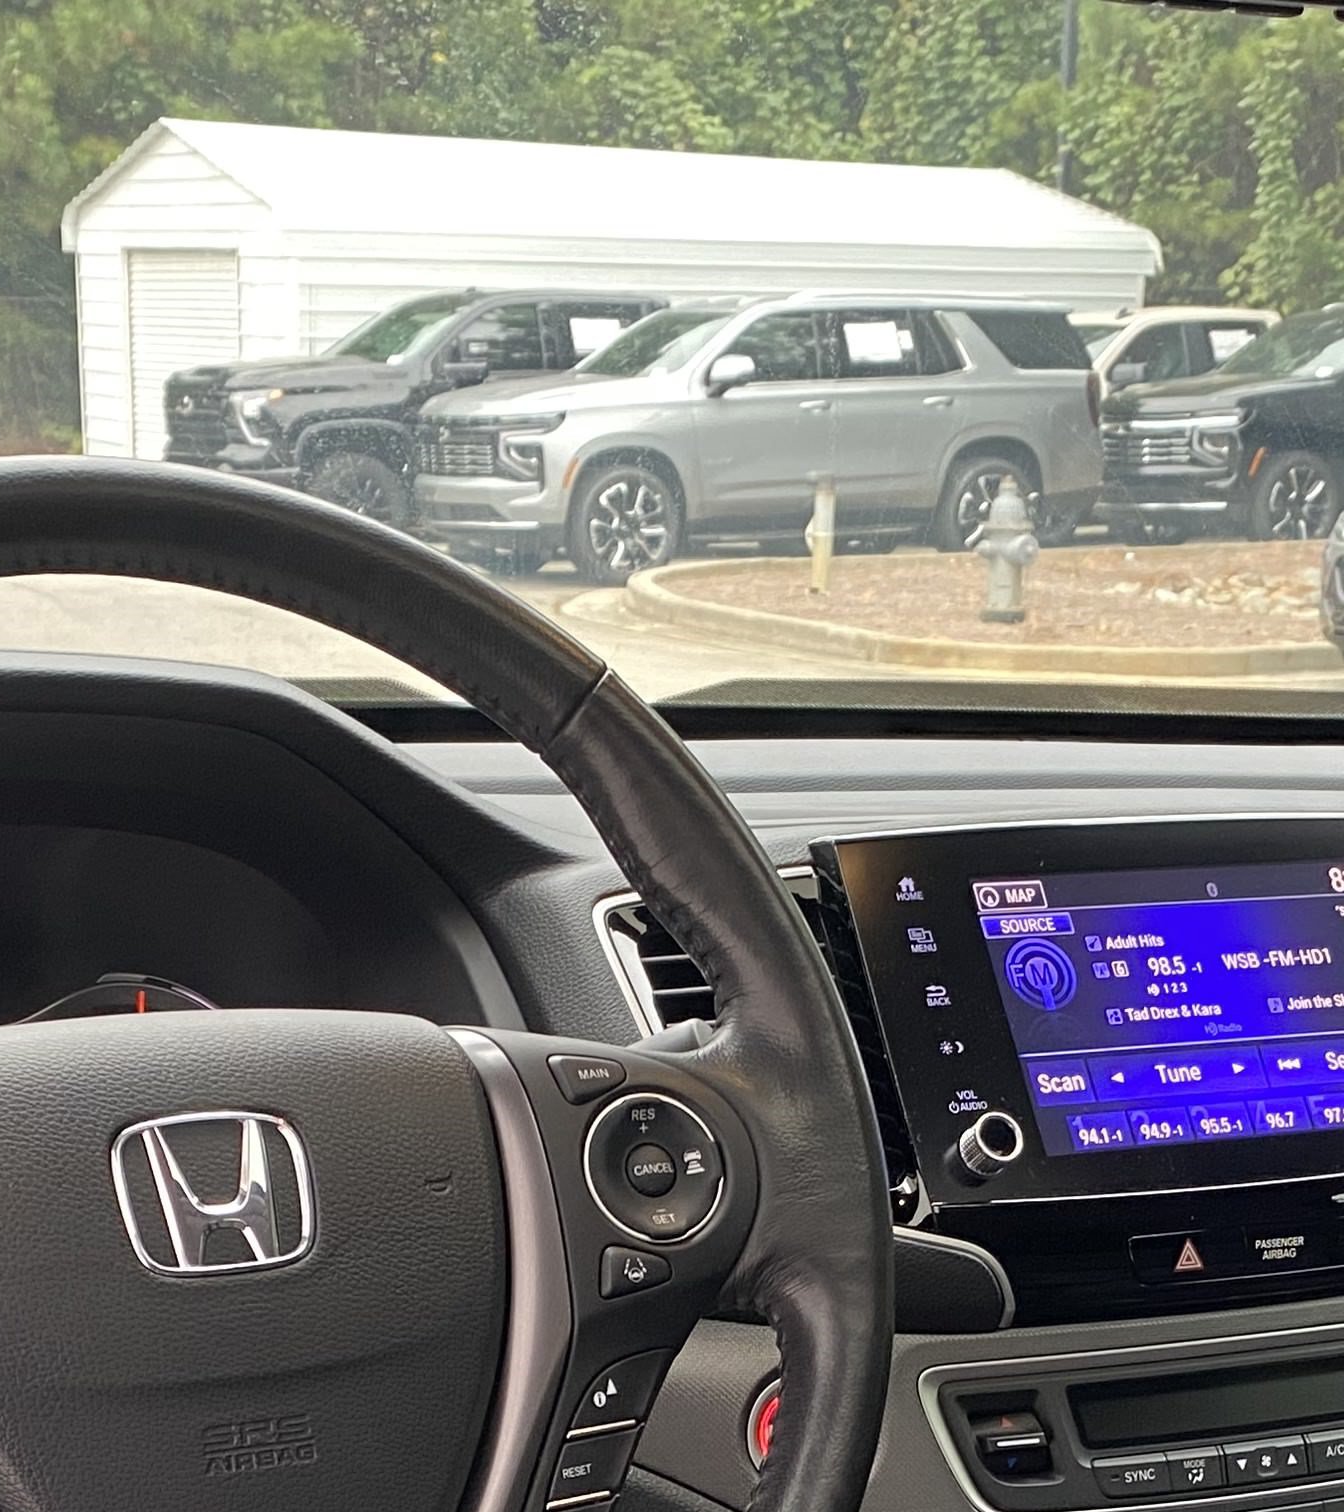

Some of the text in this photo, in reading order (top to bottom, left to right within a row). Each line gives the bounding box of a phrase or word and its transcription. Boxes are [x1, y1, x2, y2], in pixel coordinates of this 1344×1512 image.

[896, 891, 924, 901] HOME
[1005, 888, 1036, 904] MAP
[1000, 918, 1057, 934] SOURCE
[910, 943, 937, 953] MENU
[1106, 934, 1165, 950] Adult Hits
[1147, 956, 1186, 977] 98.5
[1221, 952, 1260, 970] WSB
[926, 997, 951, 1007] BACK
[1287, 997, 1312, 1011] Join
[1312, 996, 1333, 1009] the
[1125, 1004, 1222, 1022] Tad Drex & Kara
[578, 1068, 610, 1080] MAIN
[1154, 1063, 1202, 1084] Tune
[1037, 1073, 1086, 1094] Scan
[956, 1090, 978, 1101] VOL
[960, 1100, 988, 1111] AUDIO
[631, 1108, 656, 1121] RES
[1265, 1111, 1294, 1129] 96.7
[633, 1161, 674, 1176] CANCEL
[652, 1213, 676, 1225] SET
[1255, 1236, 1304, 1249] PASSENGER
[1262, 1248, 1297, 1261] AIRBAG
[562, 1462, 593, 1480] RESET
[1183, 1459, 1206, 1469] MODE
[1124, 1468, 1156, 1484] SYNC
